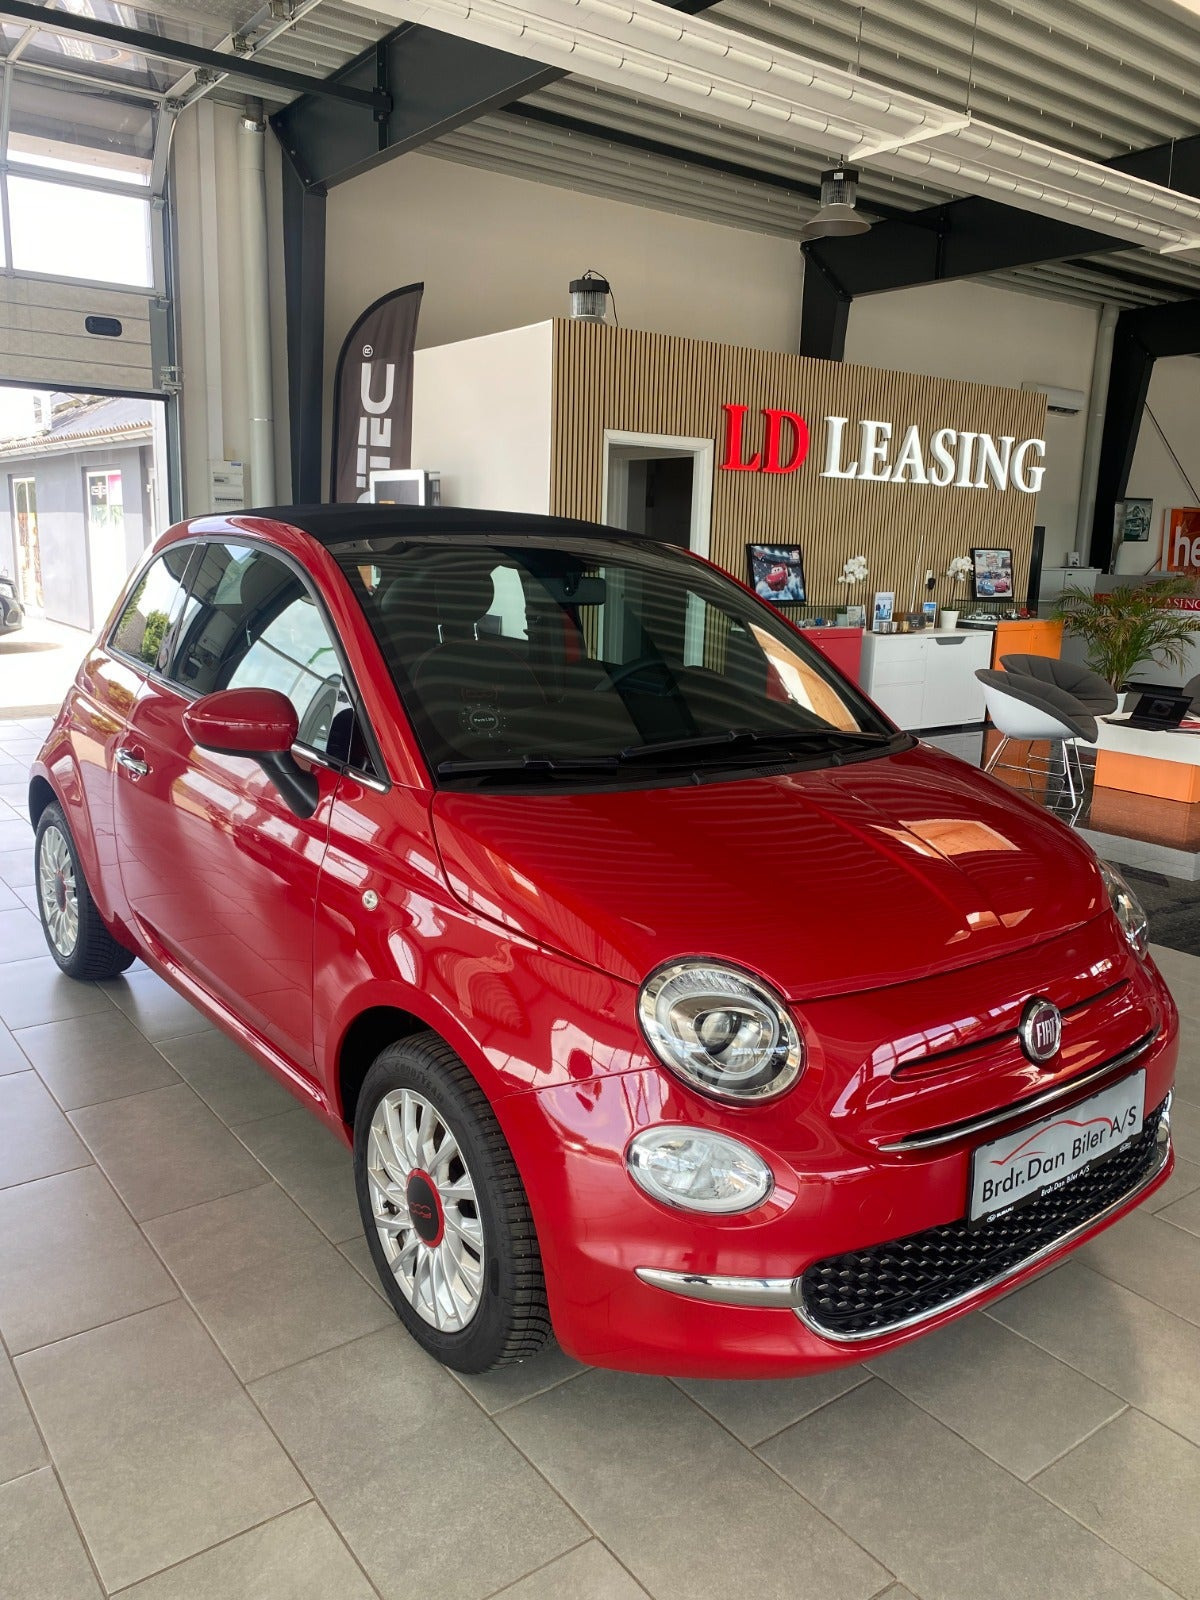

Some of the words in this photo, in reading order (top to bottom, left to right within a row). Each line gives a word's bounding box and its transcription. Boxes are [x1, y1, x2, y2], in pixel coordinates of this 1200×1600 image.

[721, 403, 810, 474] LD
[819, 416, 1046, 493] LEASING
[1036, 1016, 1055, 1048] FIAT
[1072, 1128, 1106, 1160] Biler
[1110, 1105, 1137, 1137] A/S
